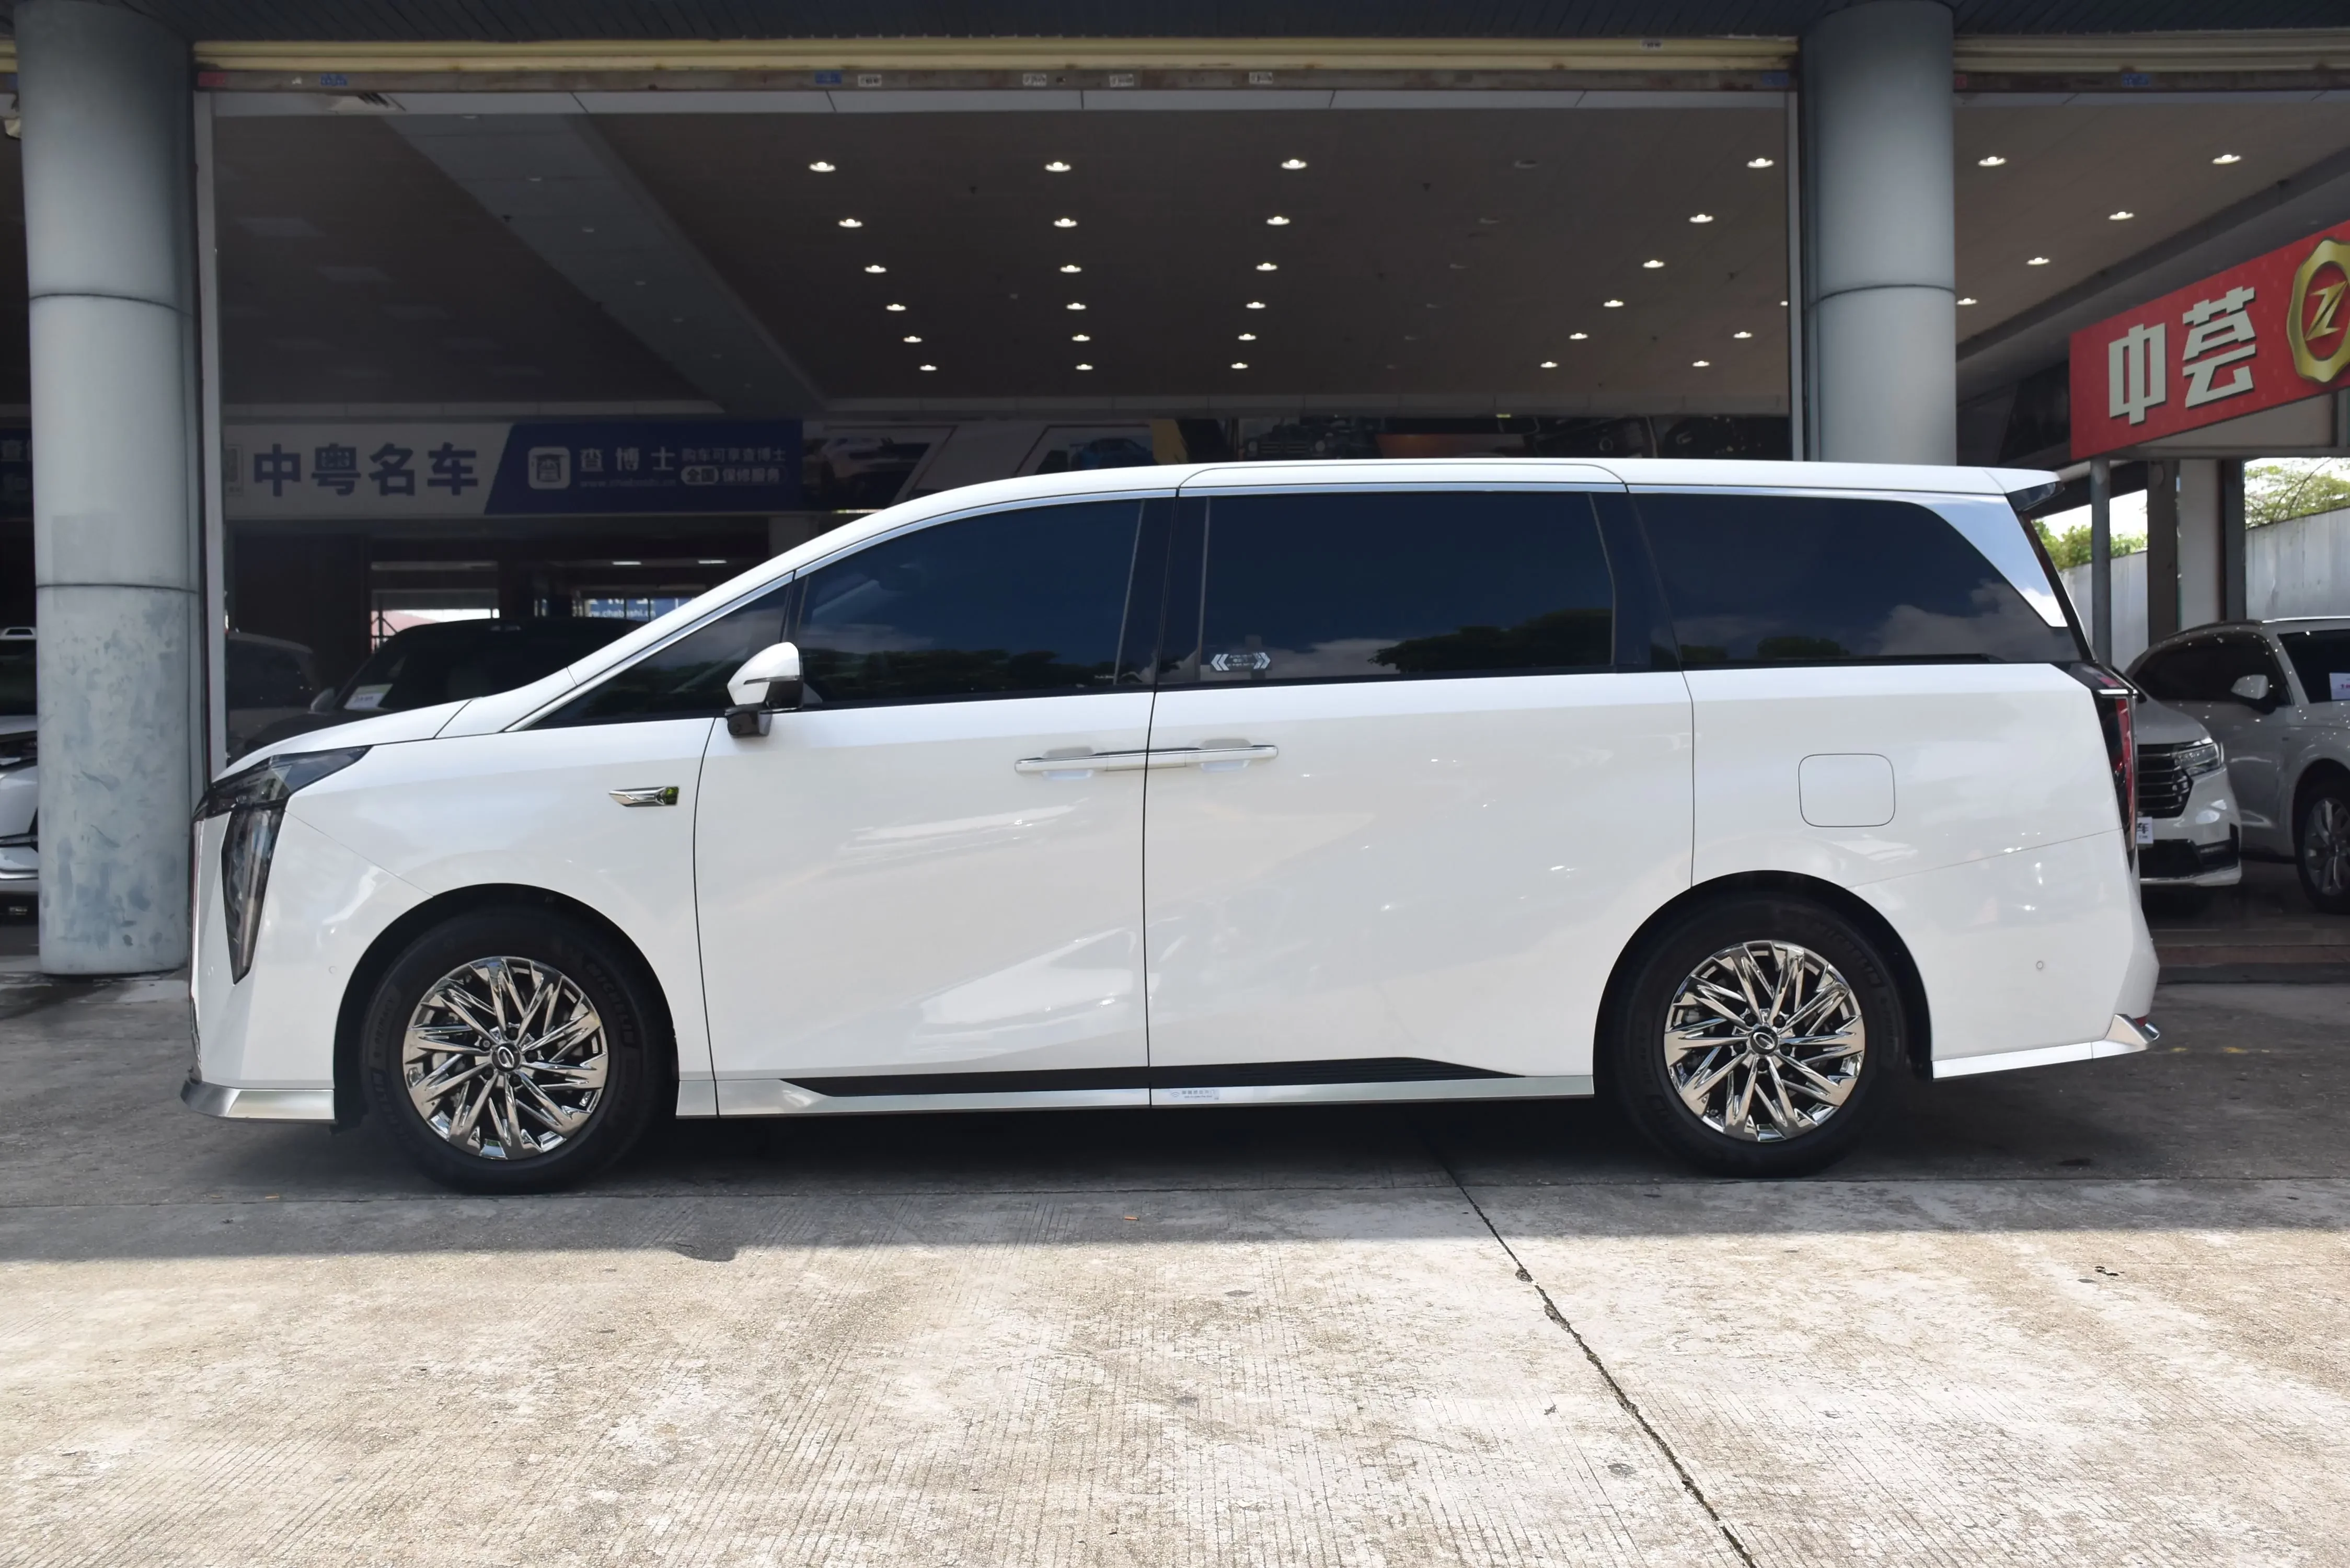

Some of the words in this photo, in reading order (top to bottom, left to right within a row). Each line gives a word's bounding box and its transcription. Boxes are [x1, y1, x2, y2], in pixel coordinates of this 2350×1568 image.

[254, 442, 478, 497] 中粤名车
[579, 446, 676, 472] 查博士
[585, 961, 636, 1045] MICHELIN
